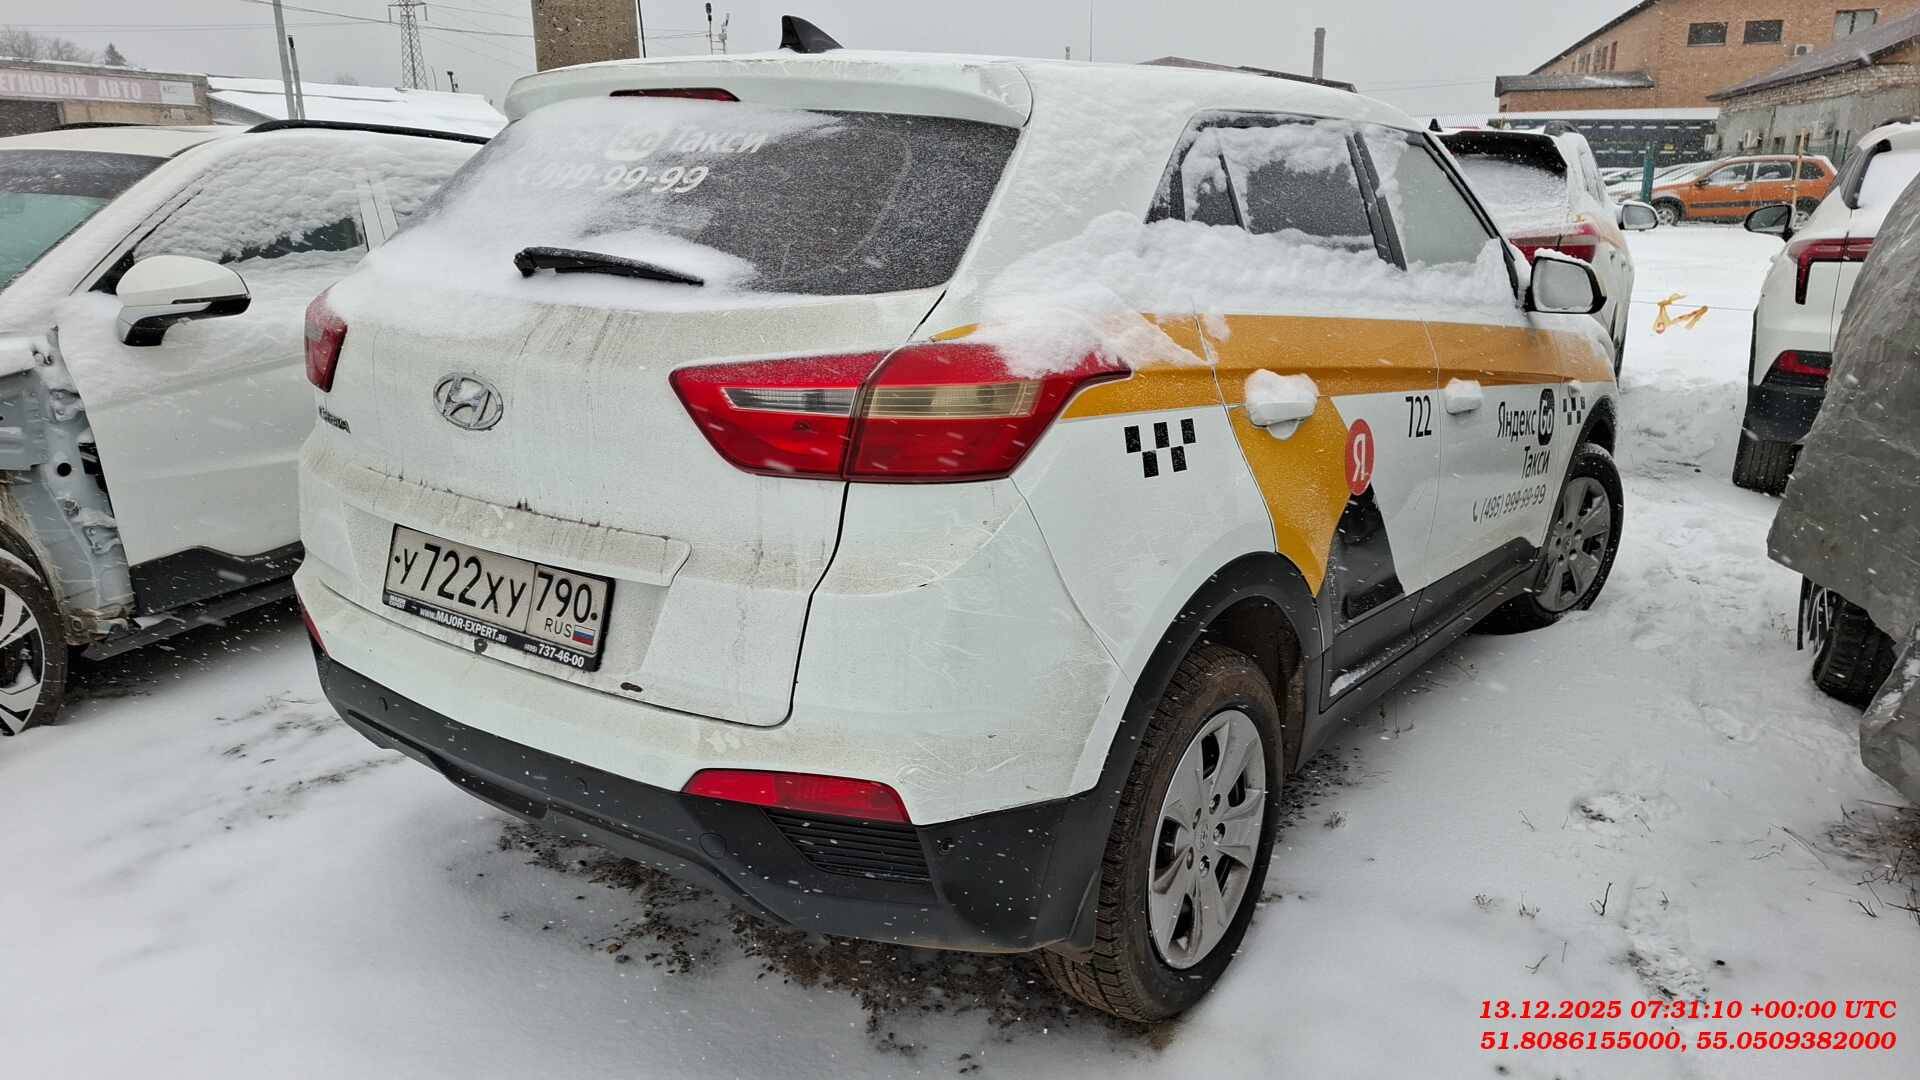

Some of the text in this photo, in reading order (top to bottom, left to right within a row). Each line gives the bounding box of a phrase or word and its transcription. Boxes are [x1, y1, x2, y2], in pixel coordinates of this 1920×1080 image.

[99, 79, 142, 98] АВТО
[1405, 394, 1432, 438] 722
[1497, 401, 1537, 442] Яндекс
[1521, 446, 1550, 479] Такси
[536, 571, 592, 623] 790
[544, 617, 573, 638] RUS
[538, 643, 585, 668] 737-46-00
